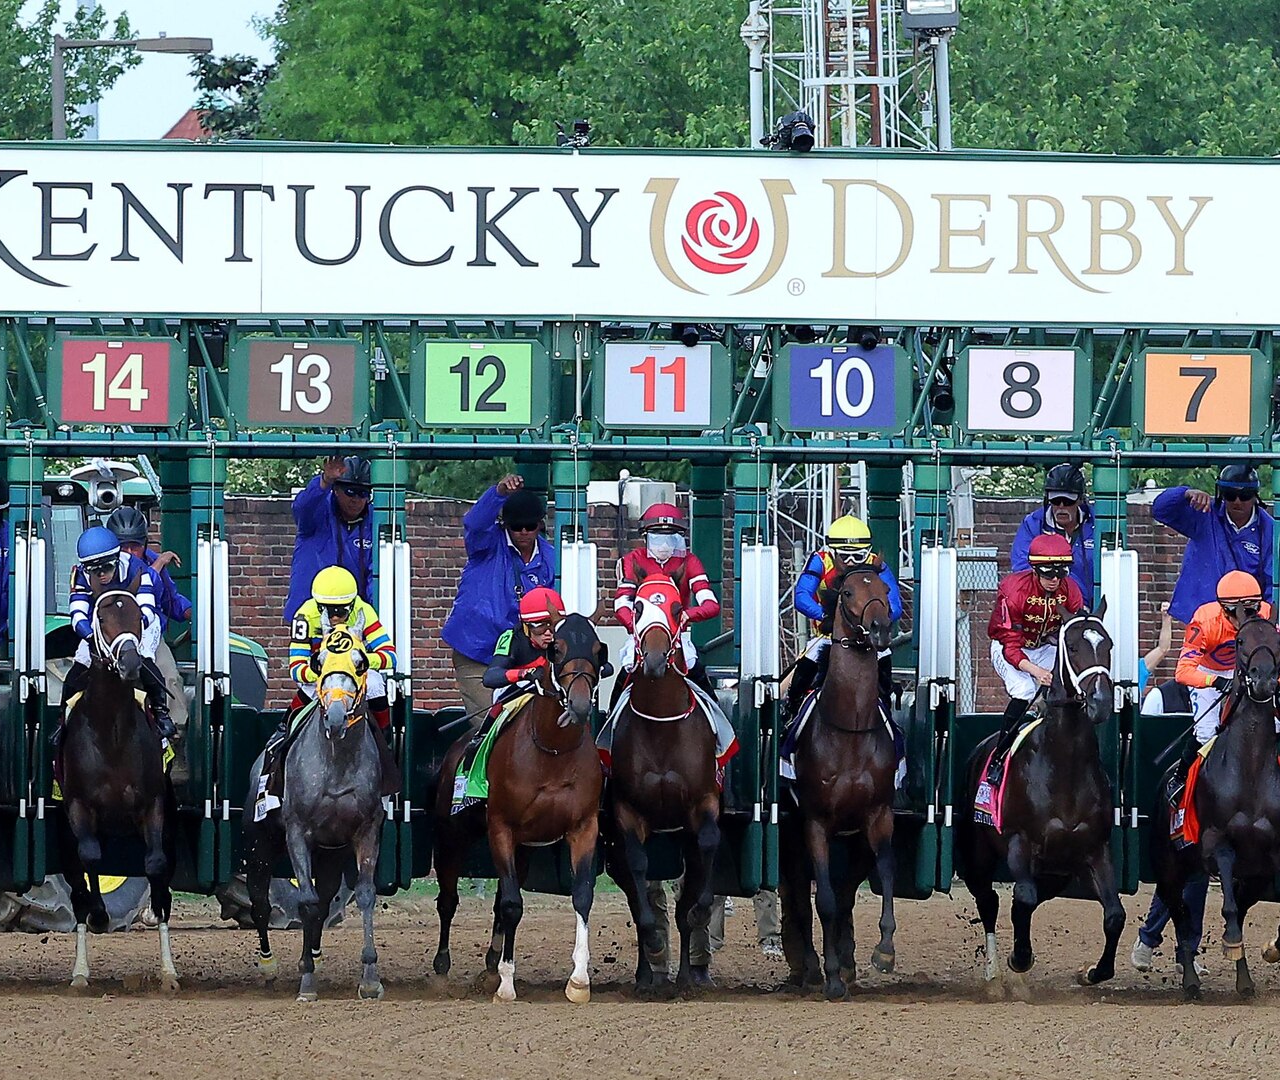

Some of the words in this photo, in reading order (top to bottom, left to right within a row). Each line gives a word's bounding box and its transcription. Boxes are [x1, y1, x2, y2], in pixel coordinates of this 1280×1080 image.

[821, 178, 1213, 294] DERBY
[81, 353, 150, 412] 14
[269, 354, 333, 414] 13
[449, 355, 507, 413] 12
[629, 356, 686, 413] 11
[809, 357, 876, 418] 10
[1000, 361, 1043, 419] 8
[1179, 366, 1218, 423] 7
[292, 619, 307, 640] 13
[497, 634, 510, 650] 12
[1188, 626, 1202, 643] 7
